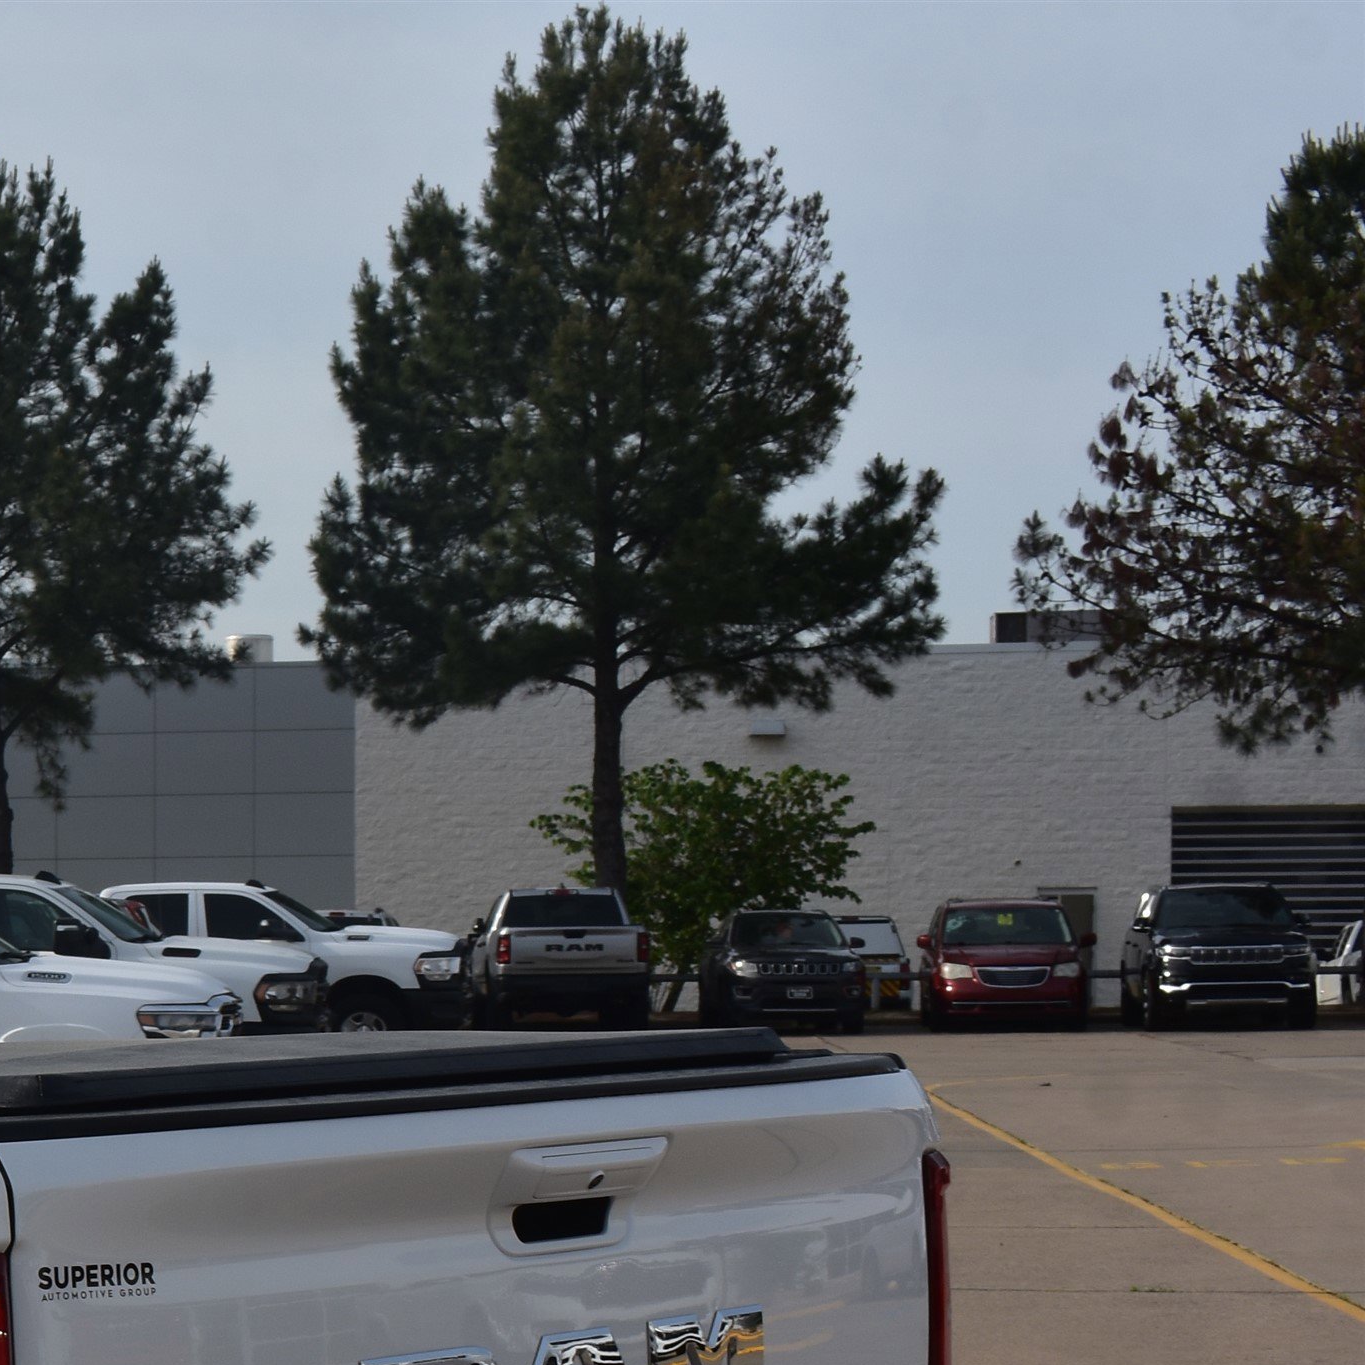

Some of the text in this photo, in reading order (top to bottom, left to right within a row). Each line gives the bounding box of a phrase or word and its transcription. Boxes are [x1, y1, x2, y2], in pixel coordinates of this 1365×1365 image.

[38, 1262, 156, 1290] SUPERIOR
[41, 1287, 157, 1302] AUTOMOTIVE GROUP
